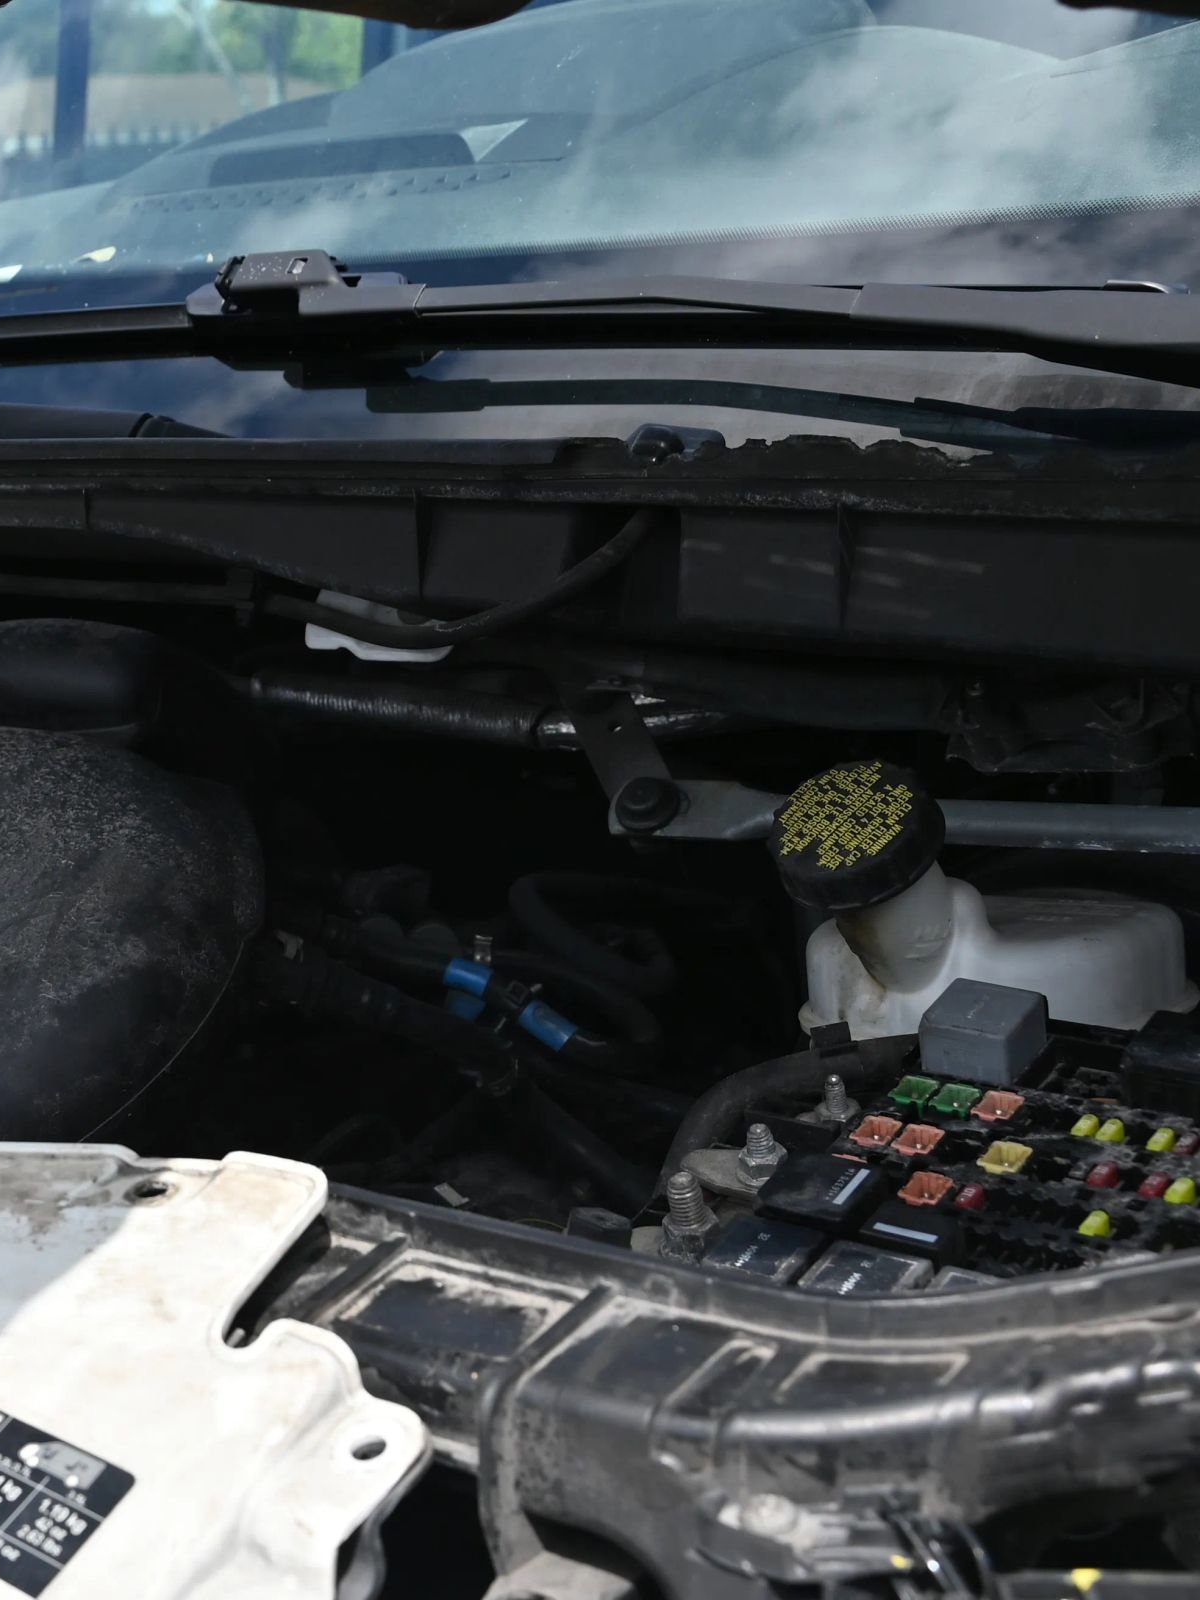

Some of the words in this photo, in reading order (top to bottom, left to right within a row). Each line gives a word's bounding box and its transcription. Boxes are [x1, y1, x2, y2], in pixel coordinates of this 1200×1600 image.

[818, 769, 838, 785] D'UN
[832, 770, 848, 783] DOT
[836, 765, 865, 789] PLOYER
[857, 762, 881, 782] AVANT
[819, 790, 836, 803] QUE
[842, 773, 881, 805] NETTOYER
[844, 782, 857, 792] DE
[886, 784, 907, 802] ONLY
[778, 786, 818, 824] CONTENANT
[832, 793, 844, 803] LE
[855, 792, 885, 817] SEALED
[869, 800, 885, 816] DOT
[882, 791, 913, 816] BEFORE
[782, 791, 824, 830] PROVENANT
[808, 805, 820, 816] DU
[829, 806, 843, 816] LE
[885, 802, 912, 826] CLEAN
[780, 816, 808, 844] LIQUIDE
[794, 819, 829, 851] BOUCHON
[816, 818, 856, 855] CONTAINER
[838, 824, 861, 845] FLUID
[858, 826, 886, 850] FILLER
[816, 846, 839, 866] FROM
[825, 854, 844, 870] USE
[843, 850, 861, 866] CAP
[2, 1480, 22, 1501] kg
[66, 1513, 87, 1535] kg
